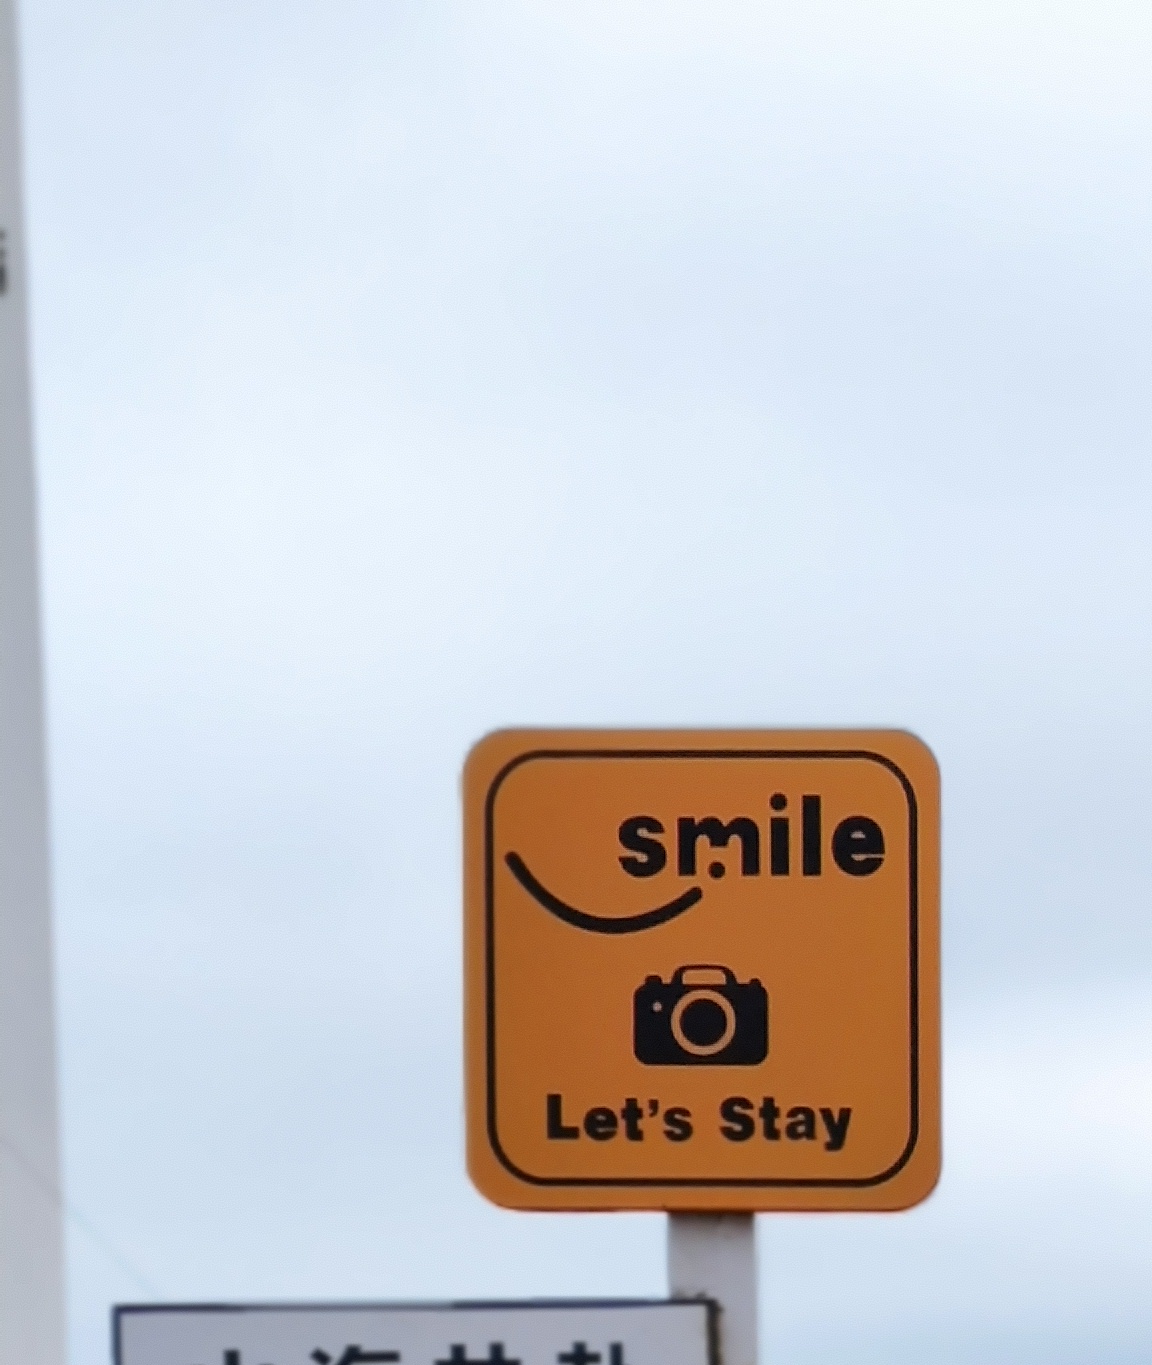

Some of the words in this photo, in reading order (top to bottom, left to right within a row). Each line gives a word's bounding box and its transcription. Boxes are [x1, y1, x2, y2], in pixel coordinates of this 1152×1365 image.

[617, 793, 886, 879] smile
[546, 1094, 693, 1143] Let's
[719, 1096, 852, 1152] Stay
